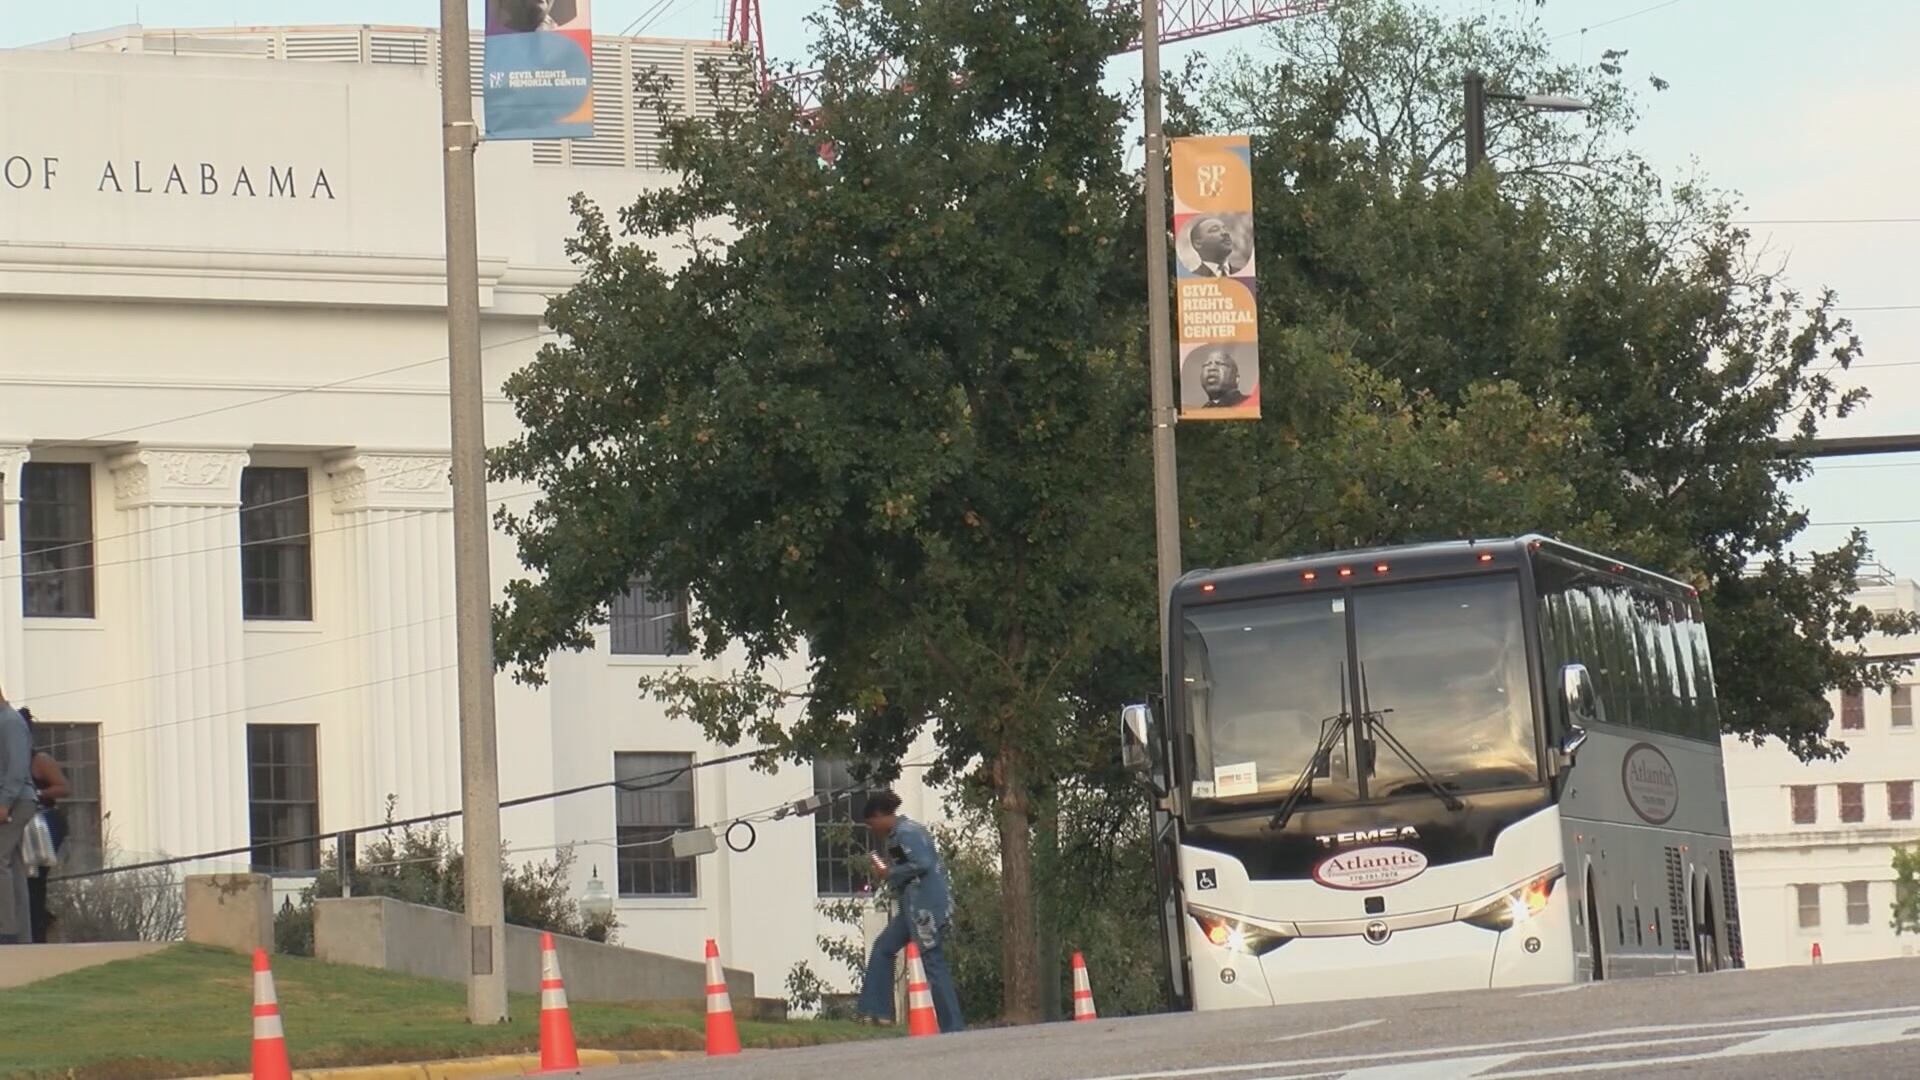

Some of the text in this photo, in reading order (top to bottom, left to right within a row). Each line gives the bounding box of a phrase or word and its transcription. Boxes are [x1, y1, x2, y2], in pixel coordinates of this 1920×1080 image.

[554, 77, 587, 87] CENTER
[4, 155, 336, 200] OF ALABAMA
[1183, 284, 1222, 297] CIVIL
[1183, 297, 1234, 311] RIGHTS
[1183, 310, 1254, 325] MEMORIAL
[1183, 325, 1236, 338] CENTER
[1315, 825, 1421, 848] TEMSA
[1327, 851, 1419, 874] Atlantic
